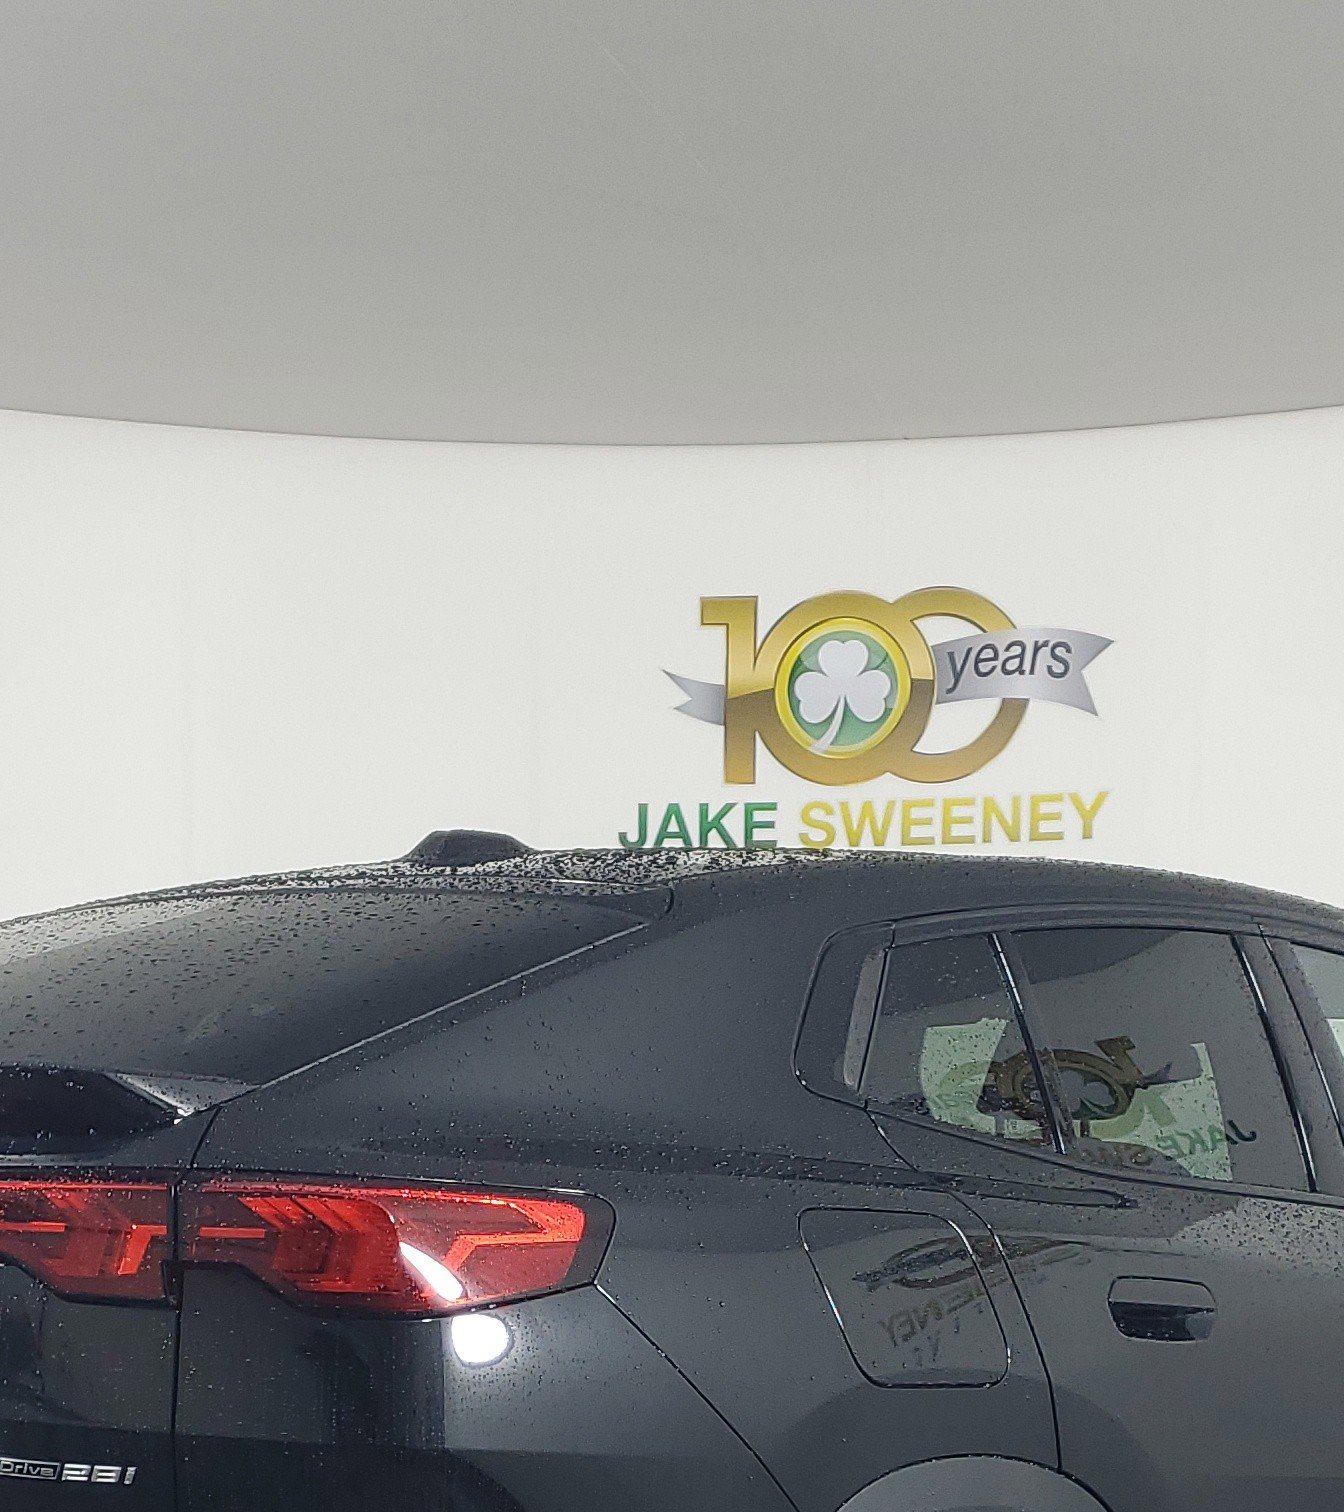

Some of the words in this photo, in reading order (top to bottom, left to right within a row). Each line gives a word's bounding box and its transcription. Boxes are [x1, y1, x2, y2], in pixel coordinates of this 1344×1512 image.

[944, 637, 1073, 695] years
[617, 800, 779, 849] JAKE
[797, 791, 1110, 849] SWEENEY
